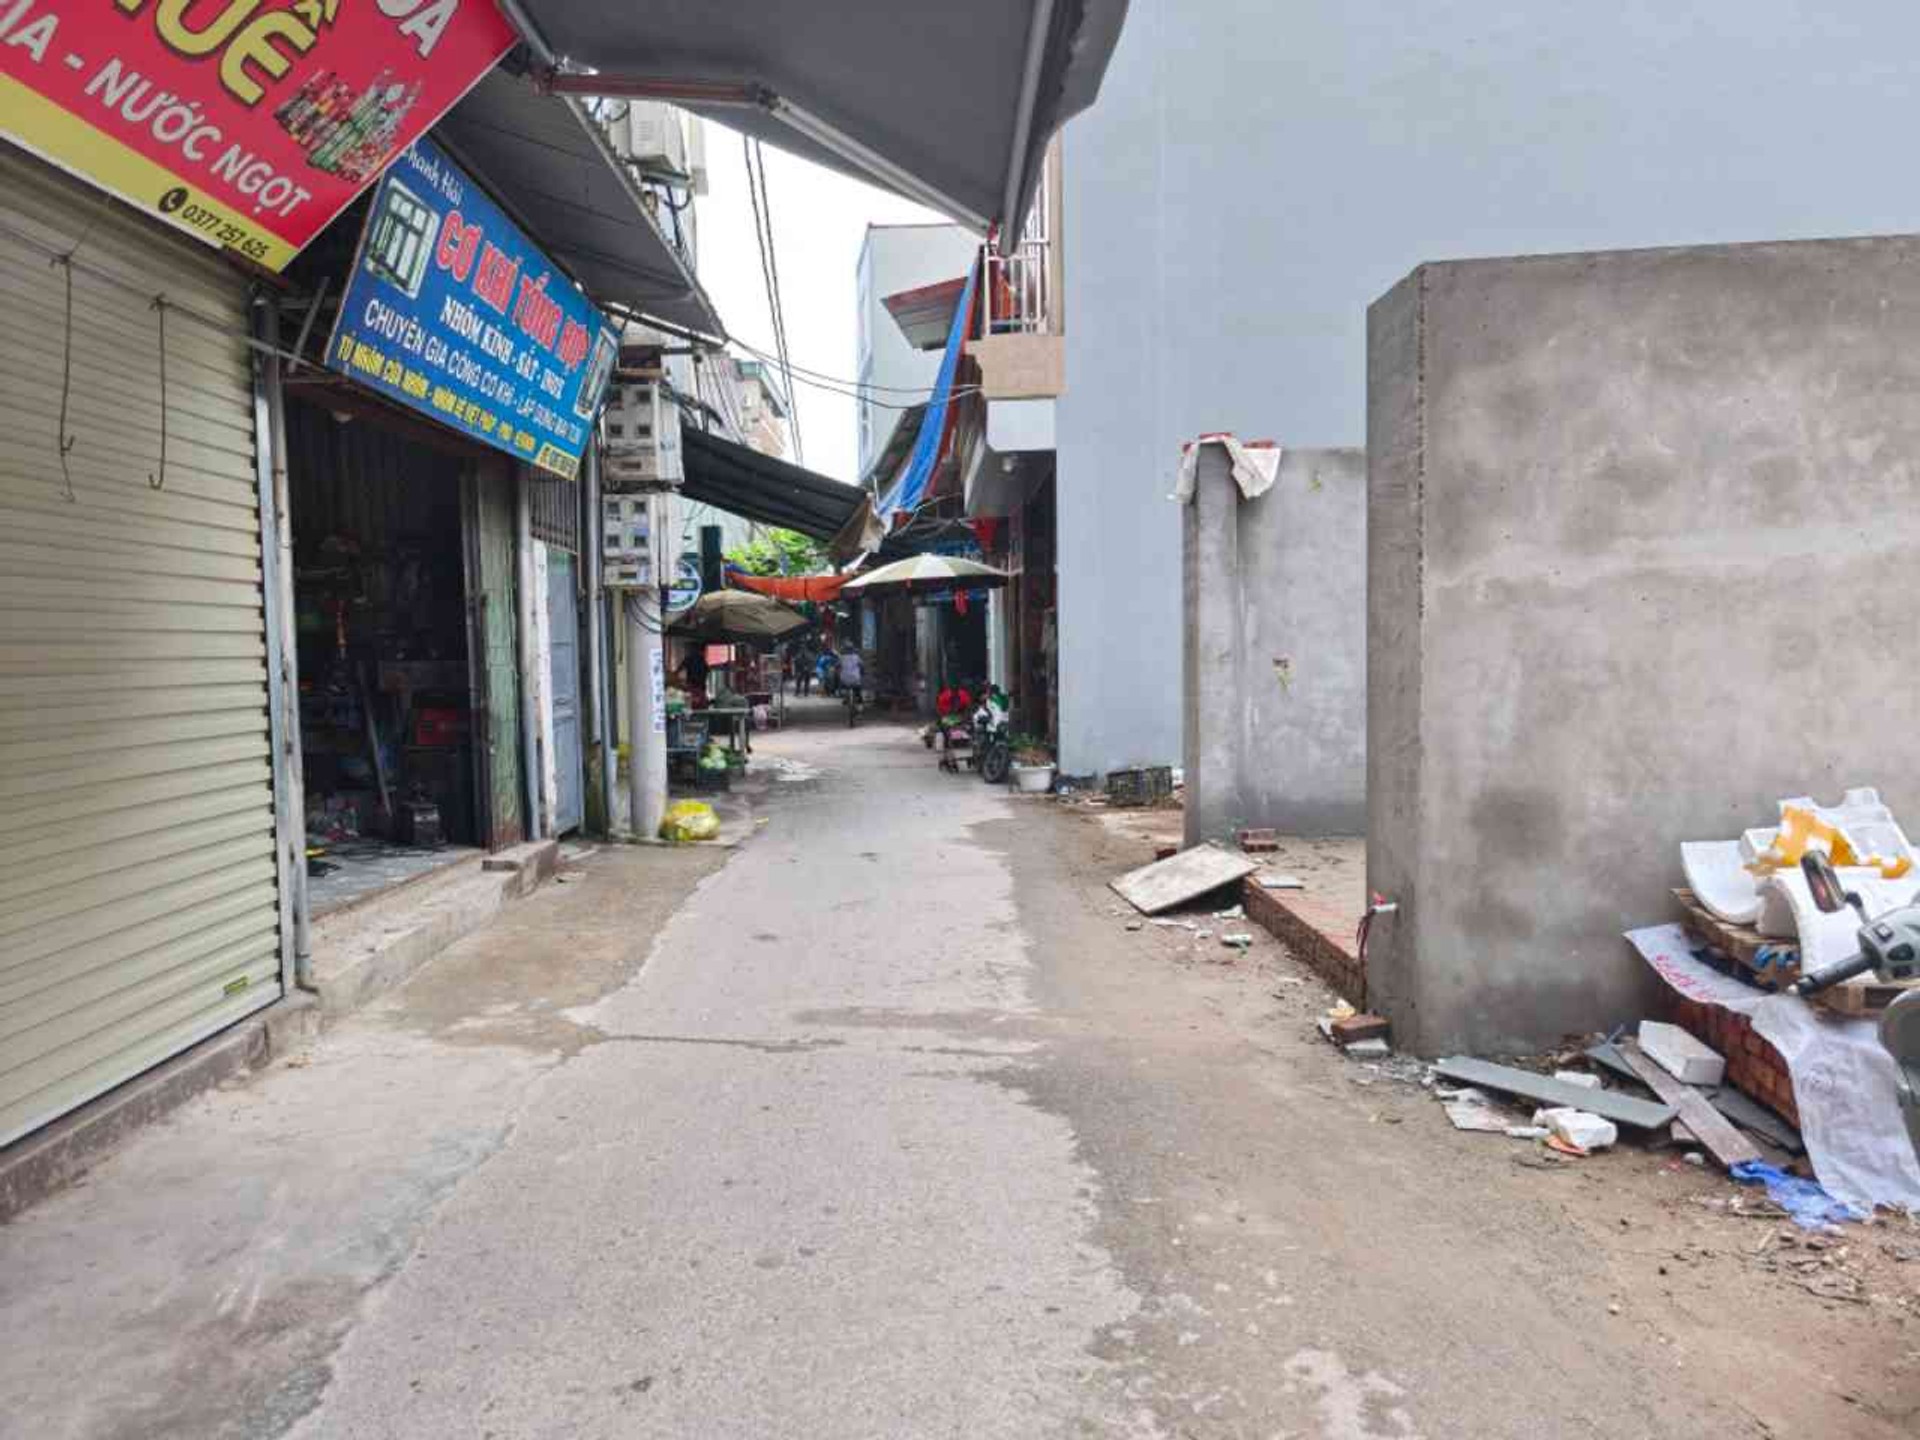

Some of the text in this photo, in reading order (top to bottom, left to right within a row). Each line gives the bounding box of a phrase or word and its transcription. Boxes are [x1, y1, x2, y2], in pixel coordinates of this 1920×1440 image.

[117, 0, 339, 106] UẾ
[376, 0, 460, 59] A
[84, 57, 222, 161] NƯỚC
[210, 144, 312, 218] NGỌT
[437, 210, 482, 283] CƠ
[364, 298, 427, 356] CHUYÊN
[425, 336, 449, 369] GIA
[439, 294, 485, 346] NHÔM
